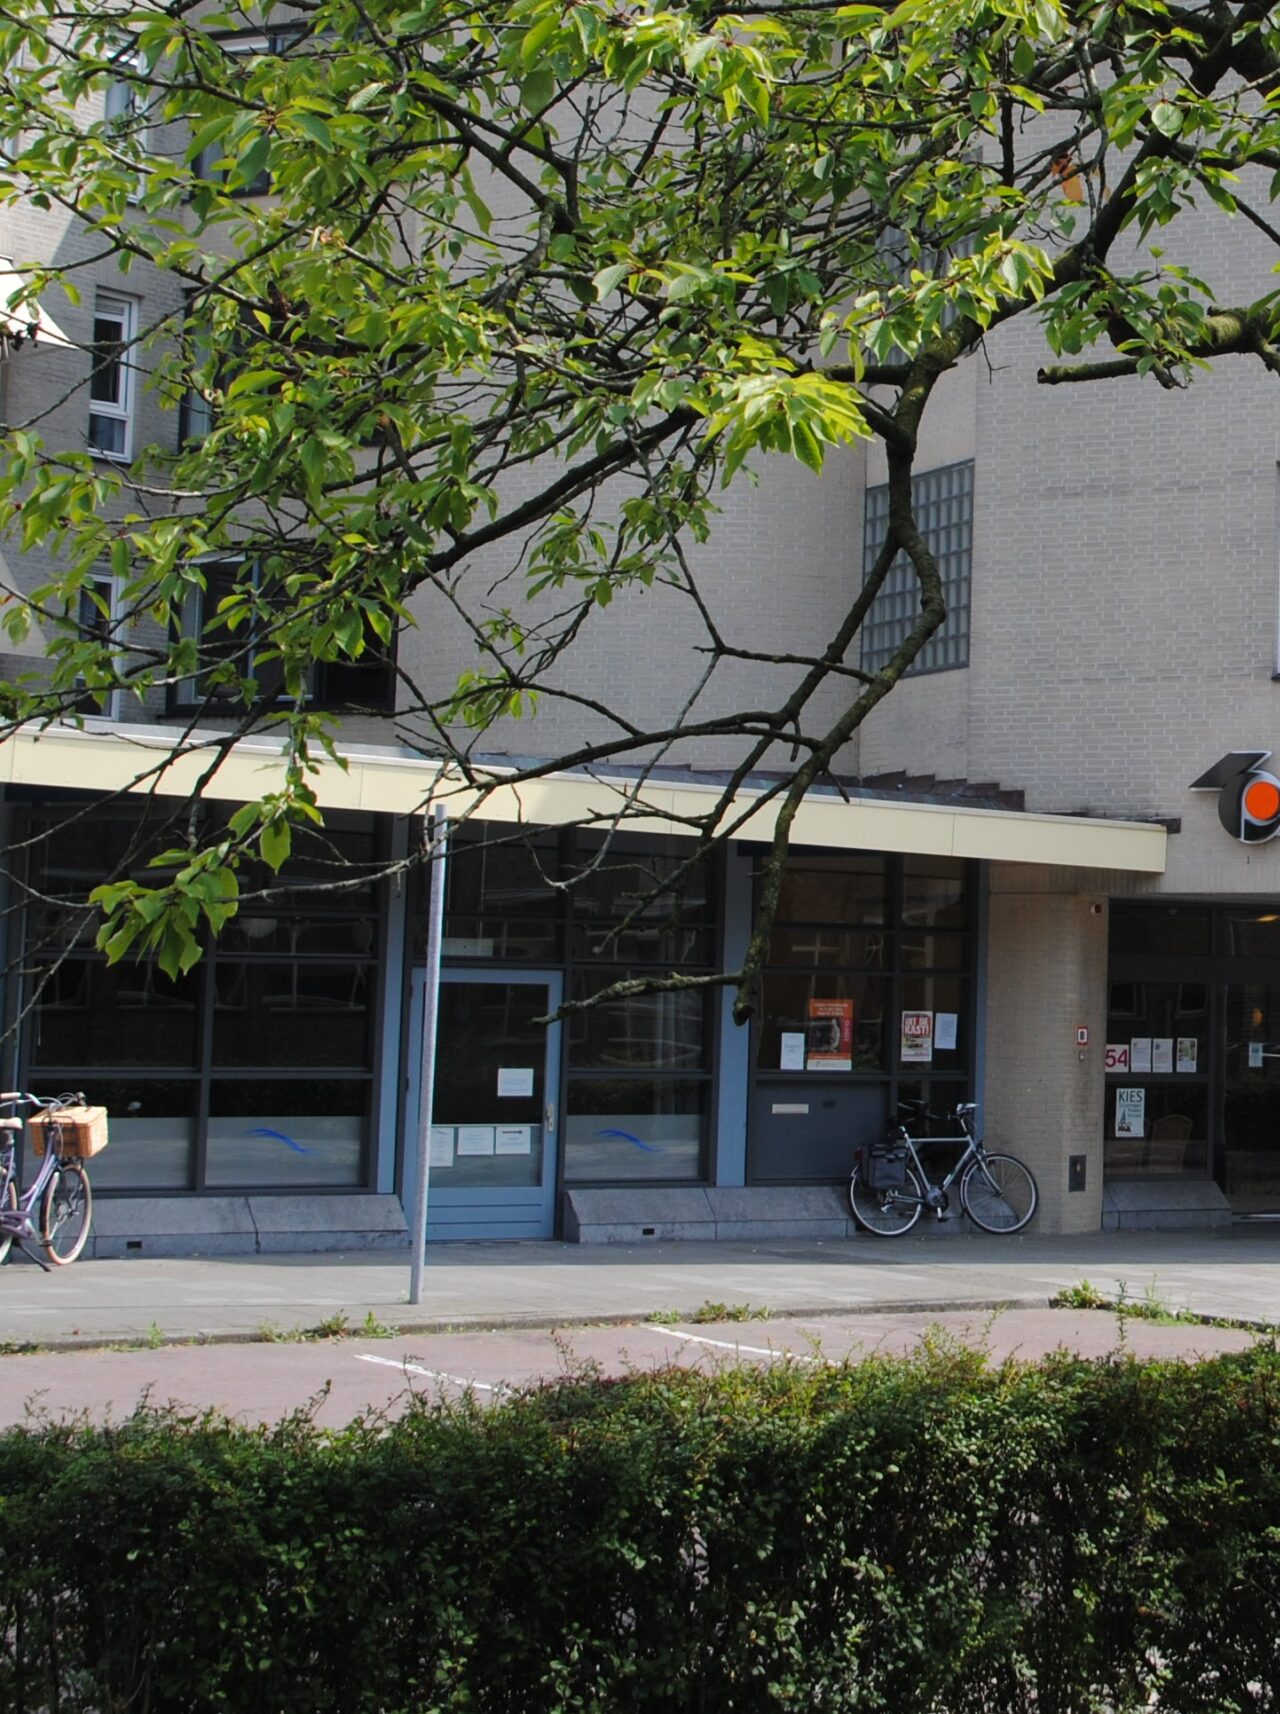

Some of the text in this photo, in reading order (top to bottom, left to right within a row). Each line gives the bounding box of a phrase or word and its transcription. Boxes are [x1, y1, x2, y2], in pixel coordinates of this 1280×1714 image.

[905, 1025, 929, 1035] KAST!
[1104, 1049, 1128, 1068] 54
[1118, 1090, 1143, 1103] KIES
